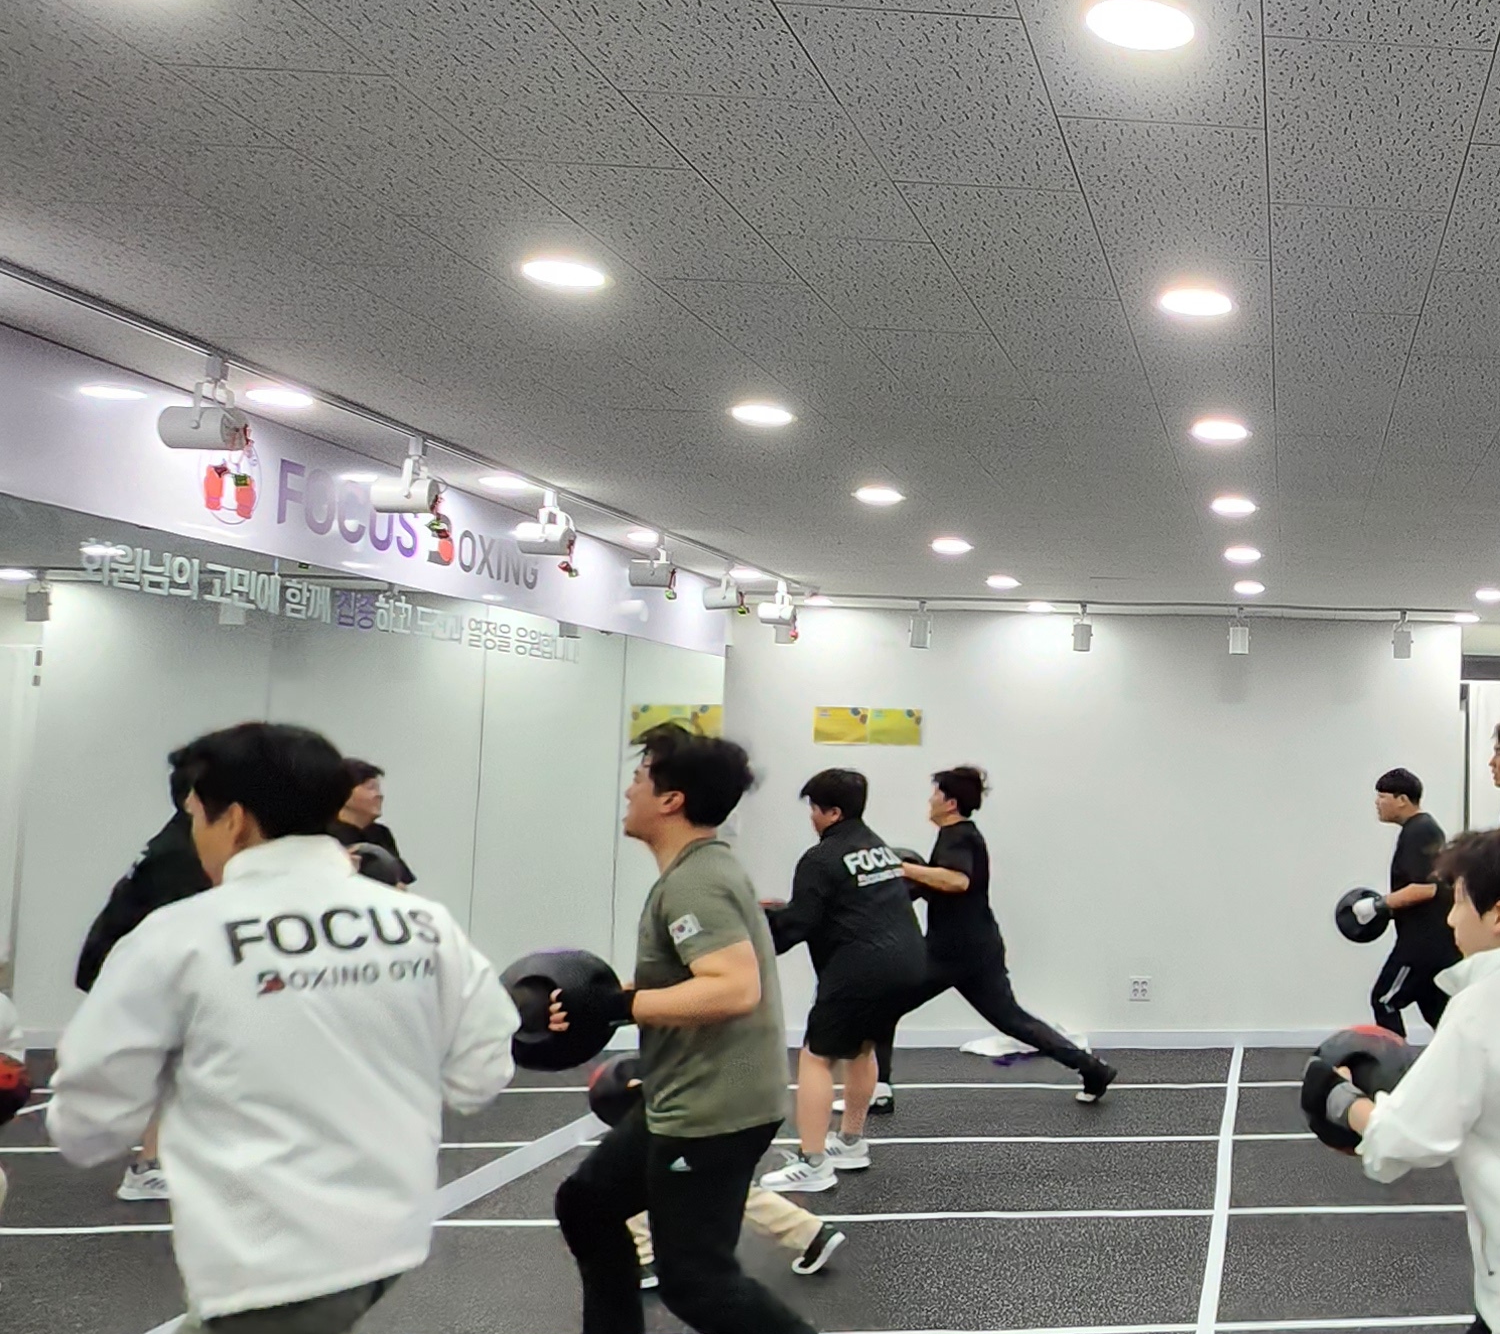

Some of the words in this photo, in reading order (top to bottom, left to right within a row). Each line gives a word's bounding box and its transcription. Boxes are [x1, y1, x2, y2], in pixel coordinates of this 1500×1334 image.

[276, 458, 419, 558] FOCUS
[80, 537, 199, 600] 회원님의
[203, 562, 281, 615] 고민에
[285, 578, 332, 624] 함께
[336, 589, 413, 635] 집중하고
[468, 617, 512, 653] 열정을
[514, 626, 580, 664] 응원합니다
[843, 846, 902, 876] FOCU
[225, 906, 440, 966] FOCUS
[257, 963, 380, 998] BOXING
